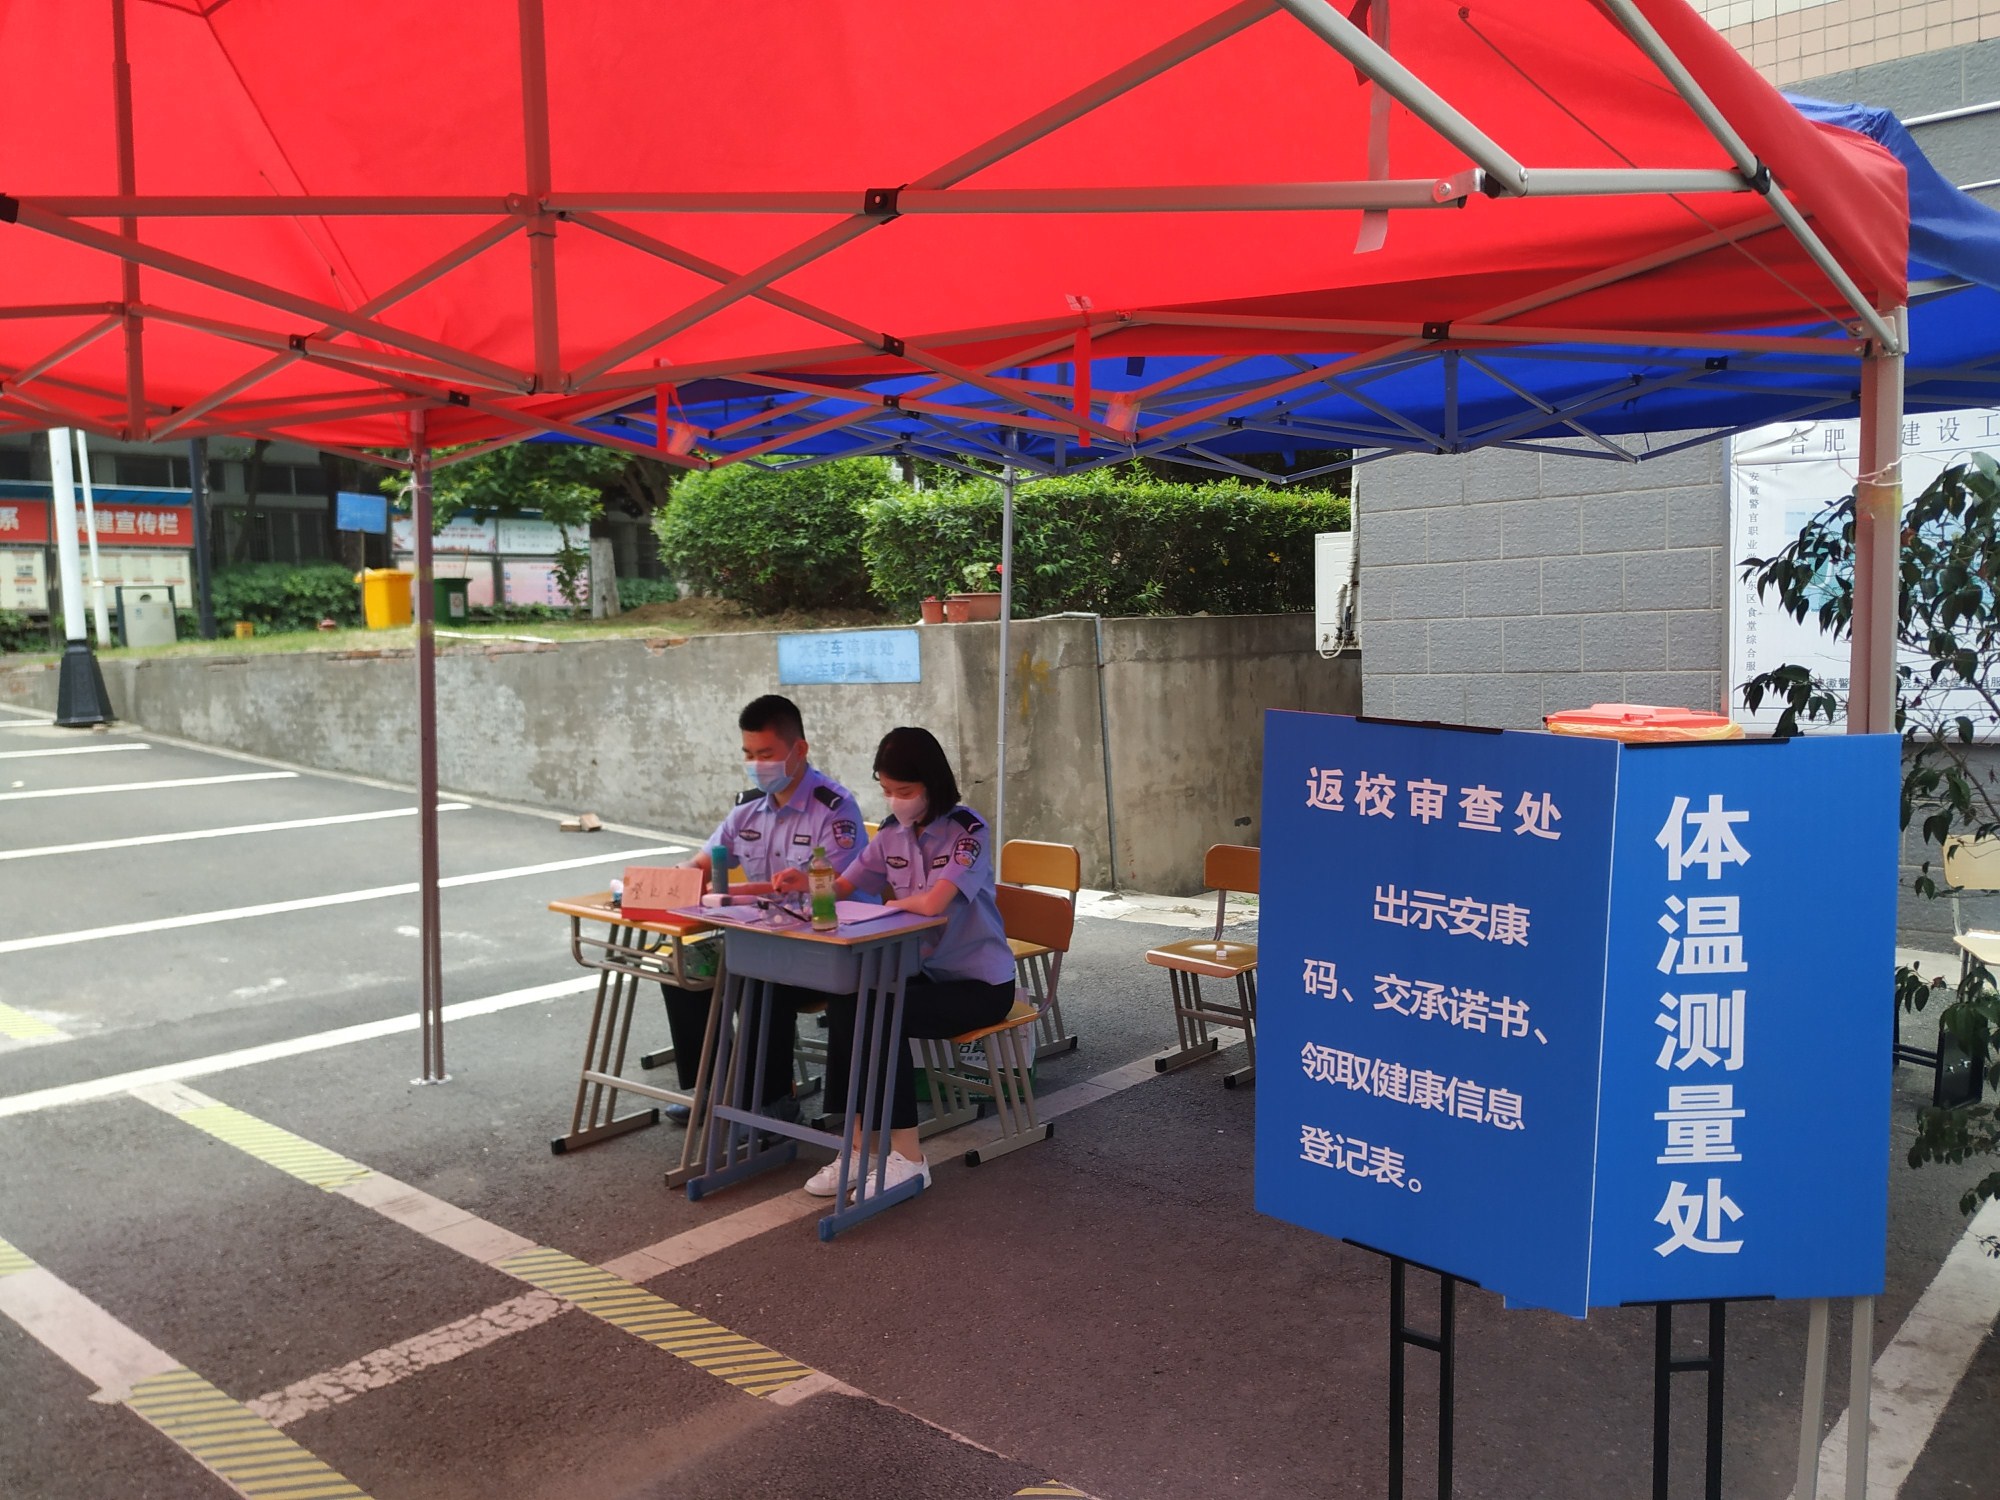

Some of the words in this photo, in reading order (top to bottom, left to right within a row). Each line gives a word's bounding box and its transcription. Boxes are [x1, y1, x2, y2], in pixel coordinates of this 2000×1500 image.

[1789, 413, 2000, 455] 合肥建设工
[1305, 767, 1563, 841] 返校审查处
[1372, 884, 1531, 948] 出示安康
[1302, 958, 1550, 1045] 码、交承诺书、
[1653, 794, 1751, 1258] 体温测量处
[1299, 1042, 1526, 1131] 领取健康信息
[1298, 1124, 1424, 1194] 登记表。
